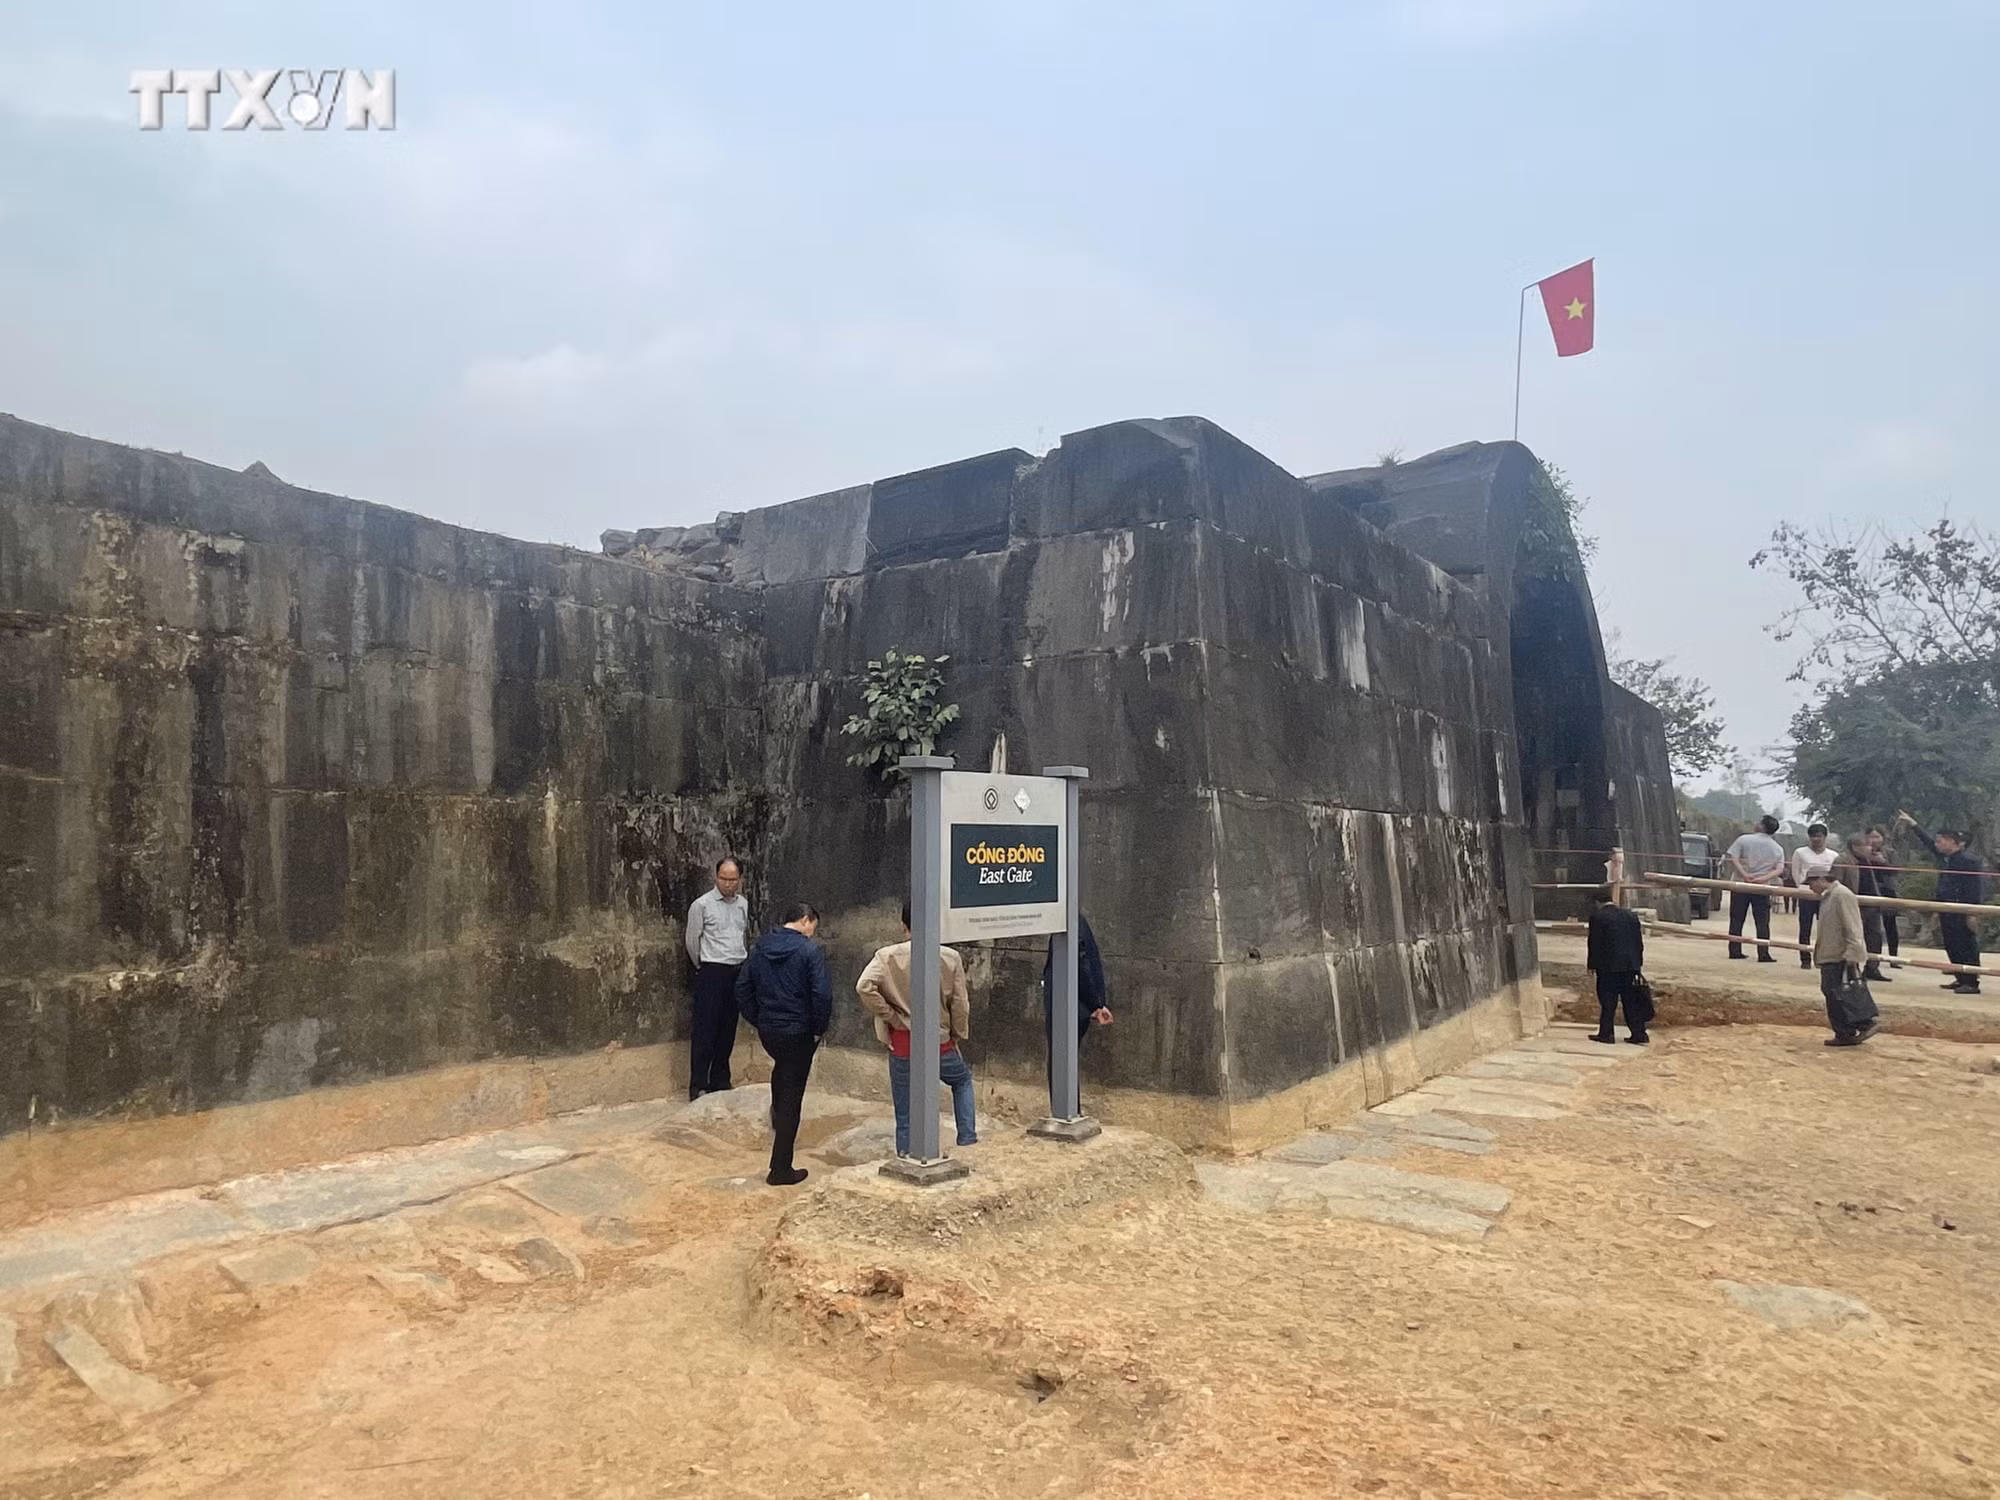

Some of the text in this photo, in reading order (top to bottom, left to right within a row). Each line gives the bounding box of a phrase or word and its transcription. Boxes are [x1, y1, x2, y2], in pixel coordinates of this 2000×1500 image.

[1007, 843, 1045, 864] ĐÔNG
[979, 866, 1033, 884] East Gate
